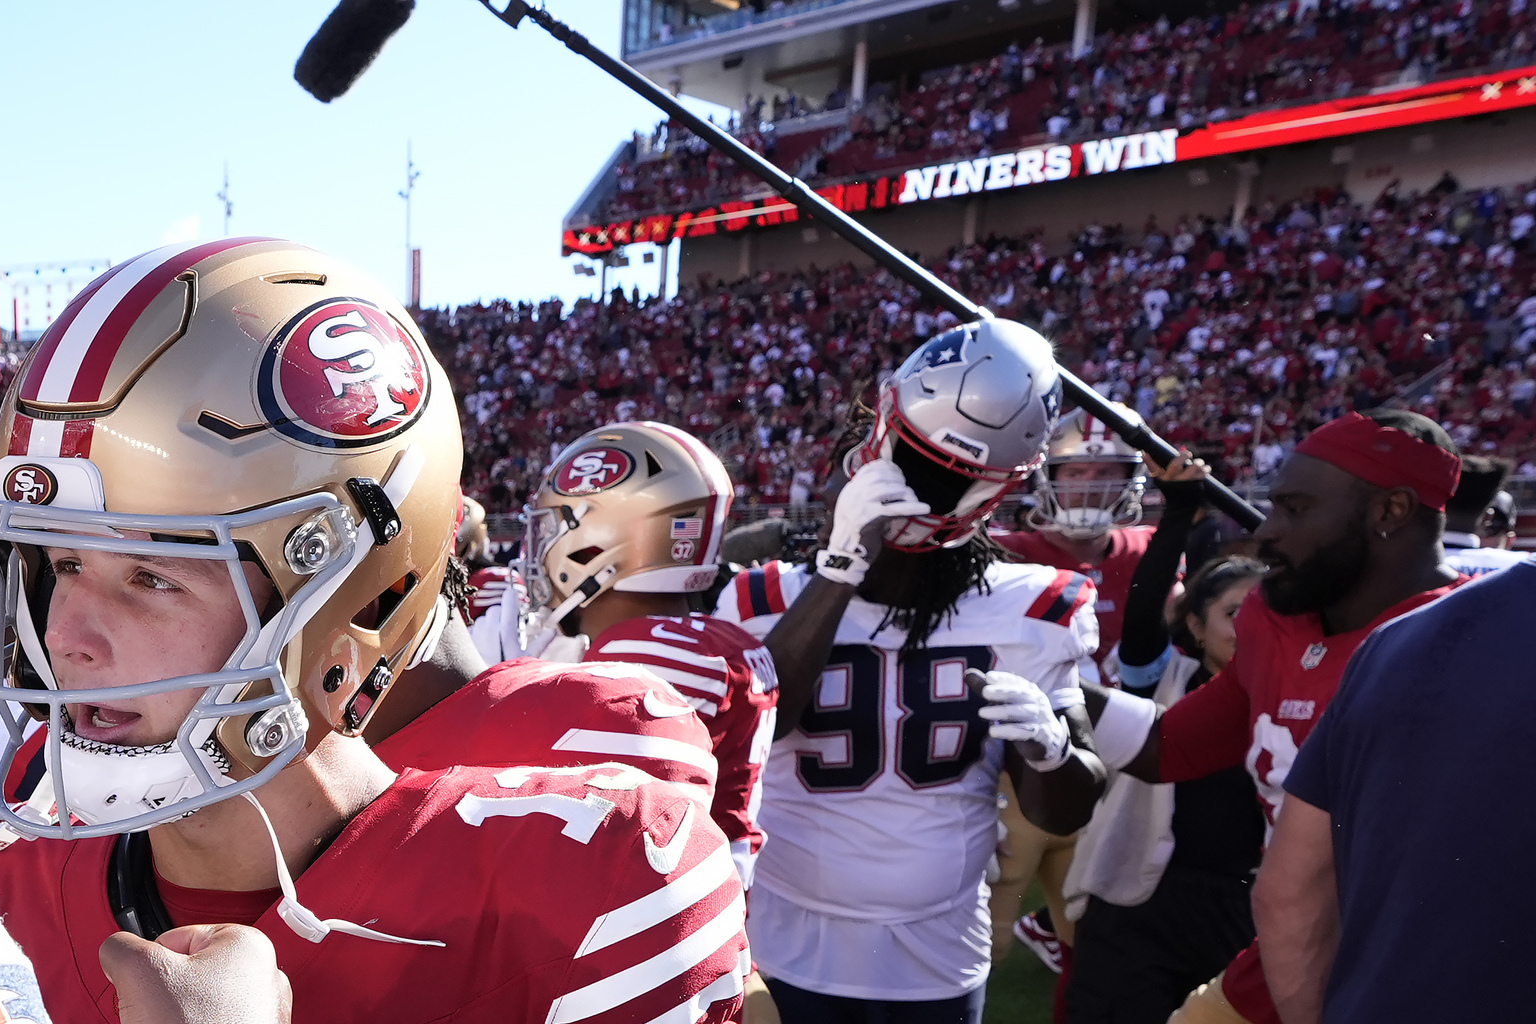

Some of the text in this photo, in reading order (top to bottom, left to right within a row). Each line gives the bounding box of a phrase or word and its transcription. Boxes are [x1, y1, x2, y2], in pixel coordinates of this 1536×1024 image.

[897, 128, 1179, 203] NINERS WIN
[795, 643, 998, 794] 98
